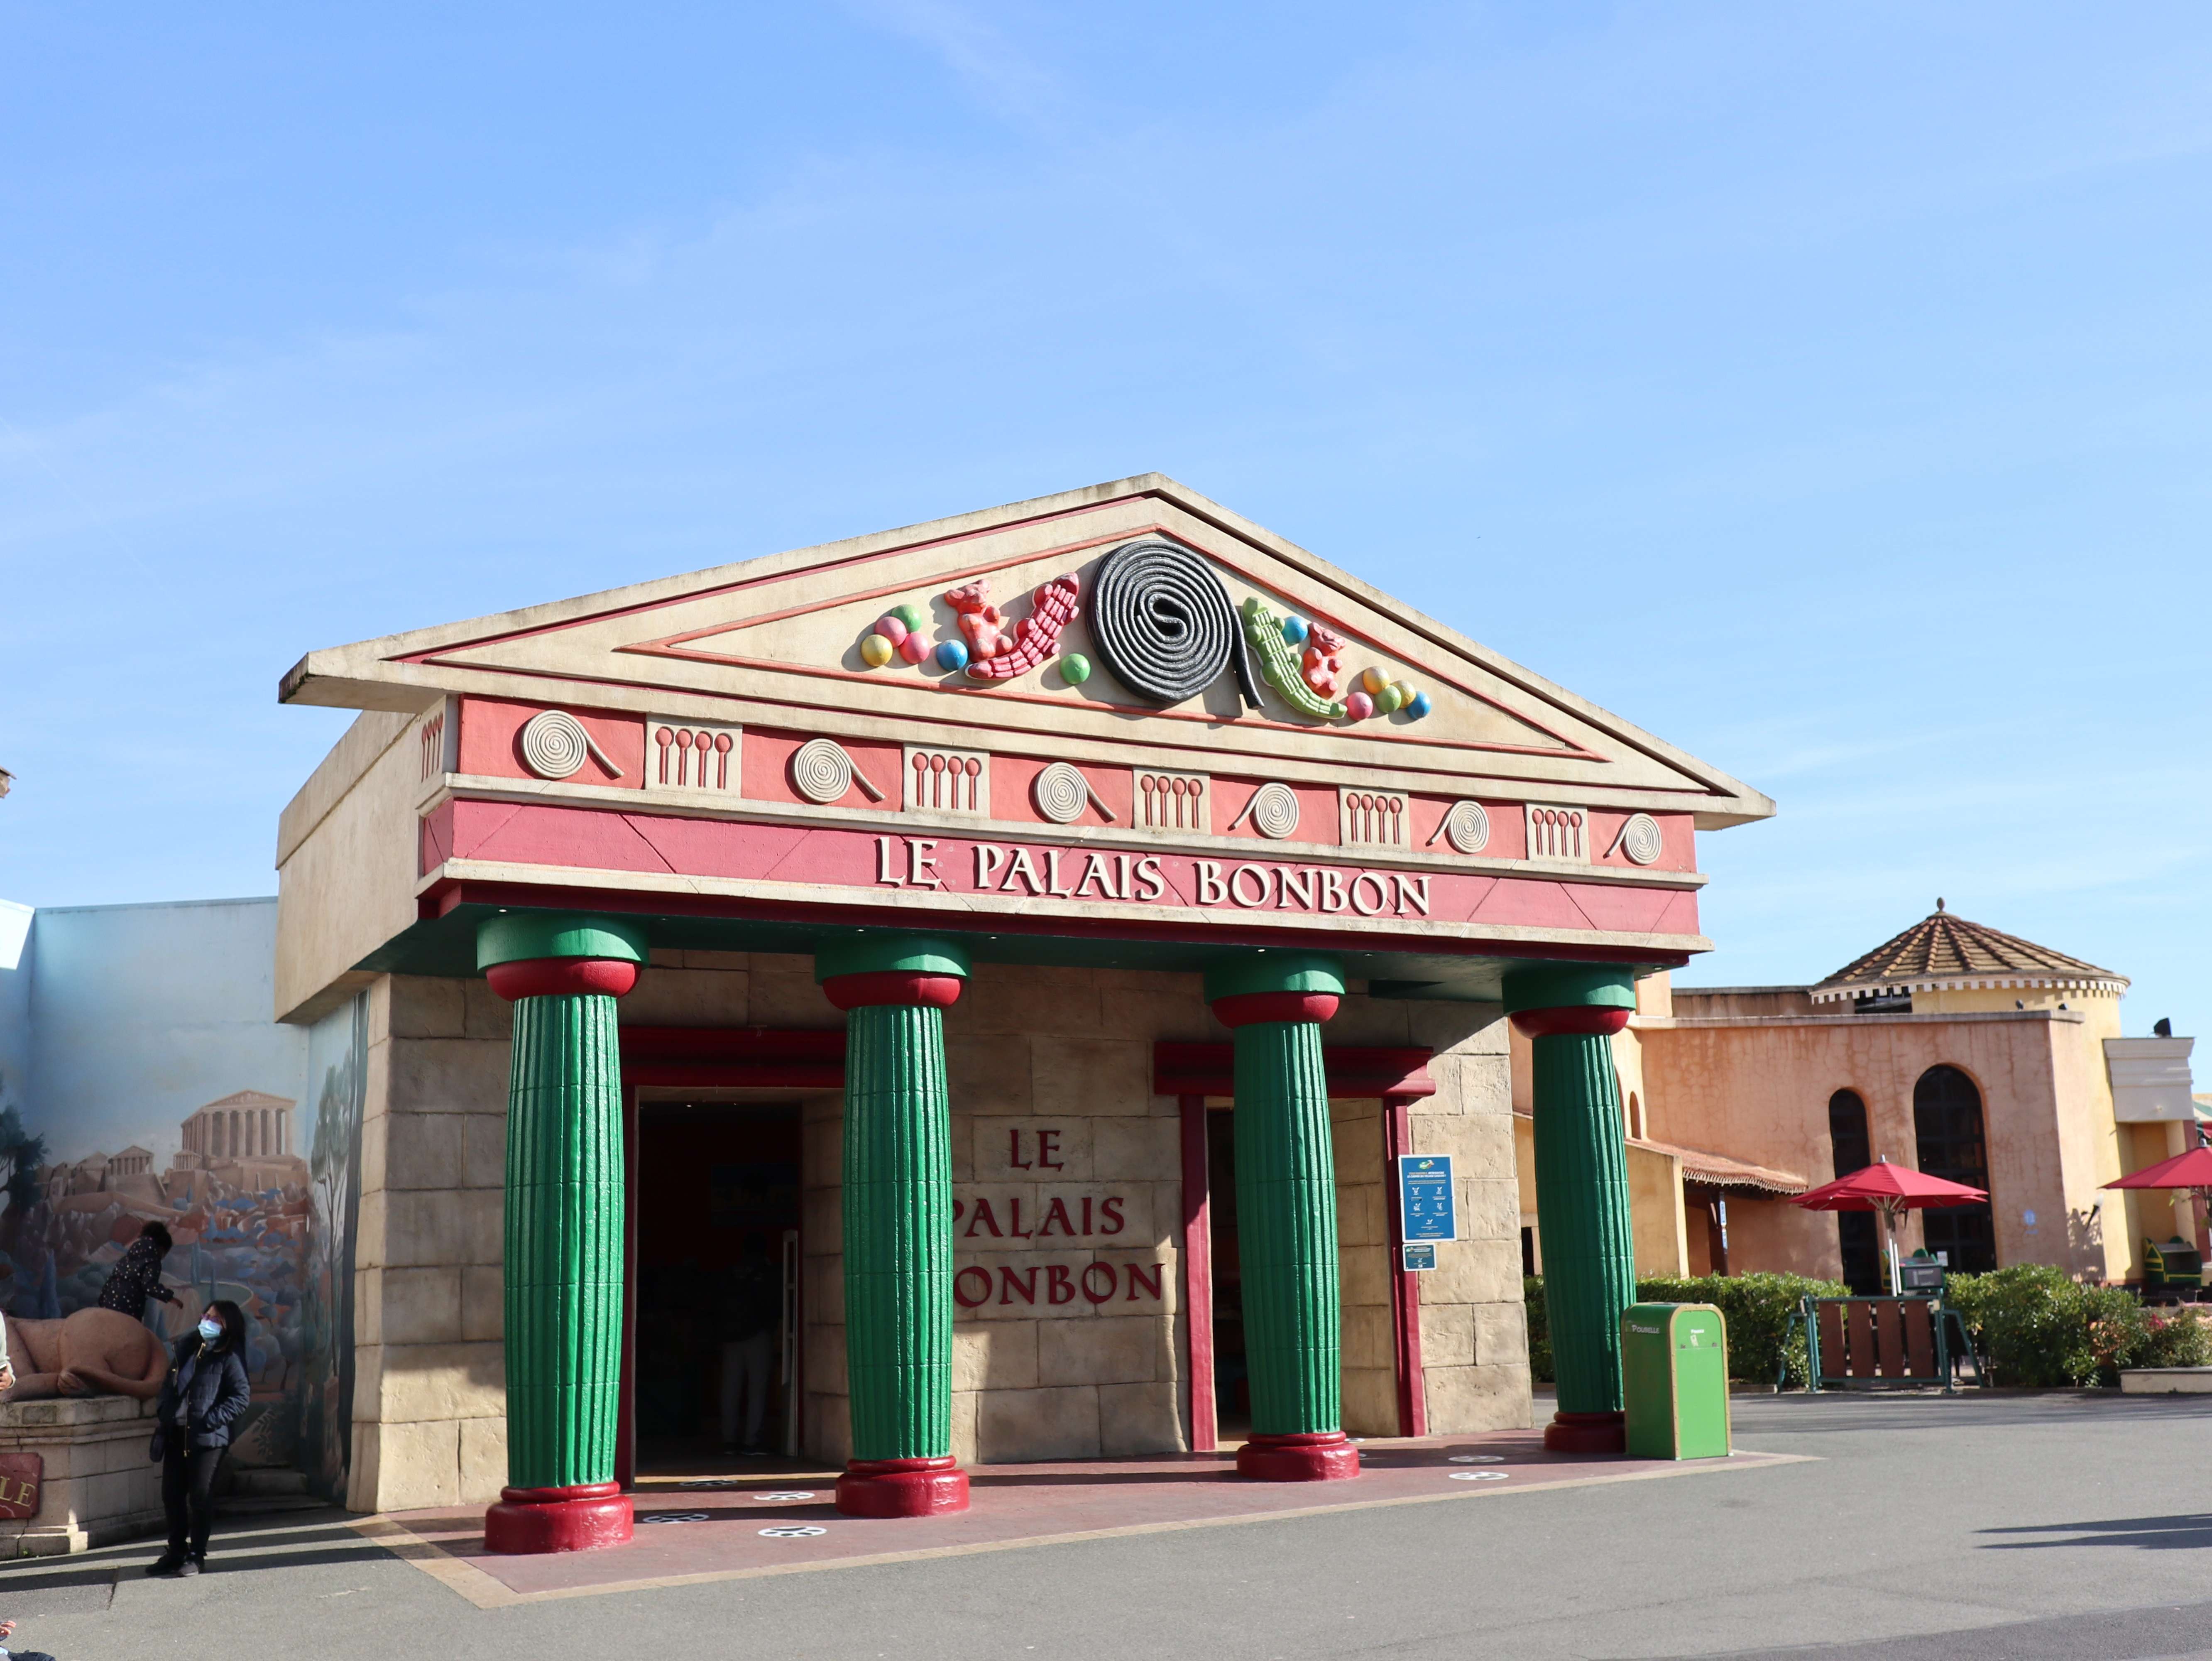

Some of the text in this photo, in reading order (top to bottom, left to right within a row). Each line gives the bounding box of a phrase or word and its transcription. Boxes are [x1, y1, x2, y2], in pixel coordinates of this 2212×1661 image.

[877, 836, 1432, 916] LE PALAIS BONBON
[1009, 1129, 1064, 1172] LE
[954, 1261, 1166, 1308] ONBON
[1631, 1324, 1660, 1334] POUBELLE
